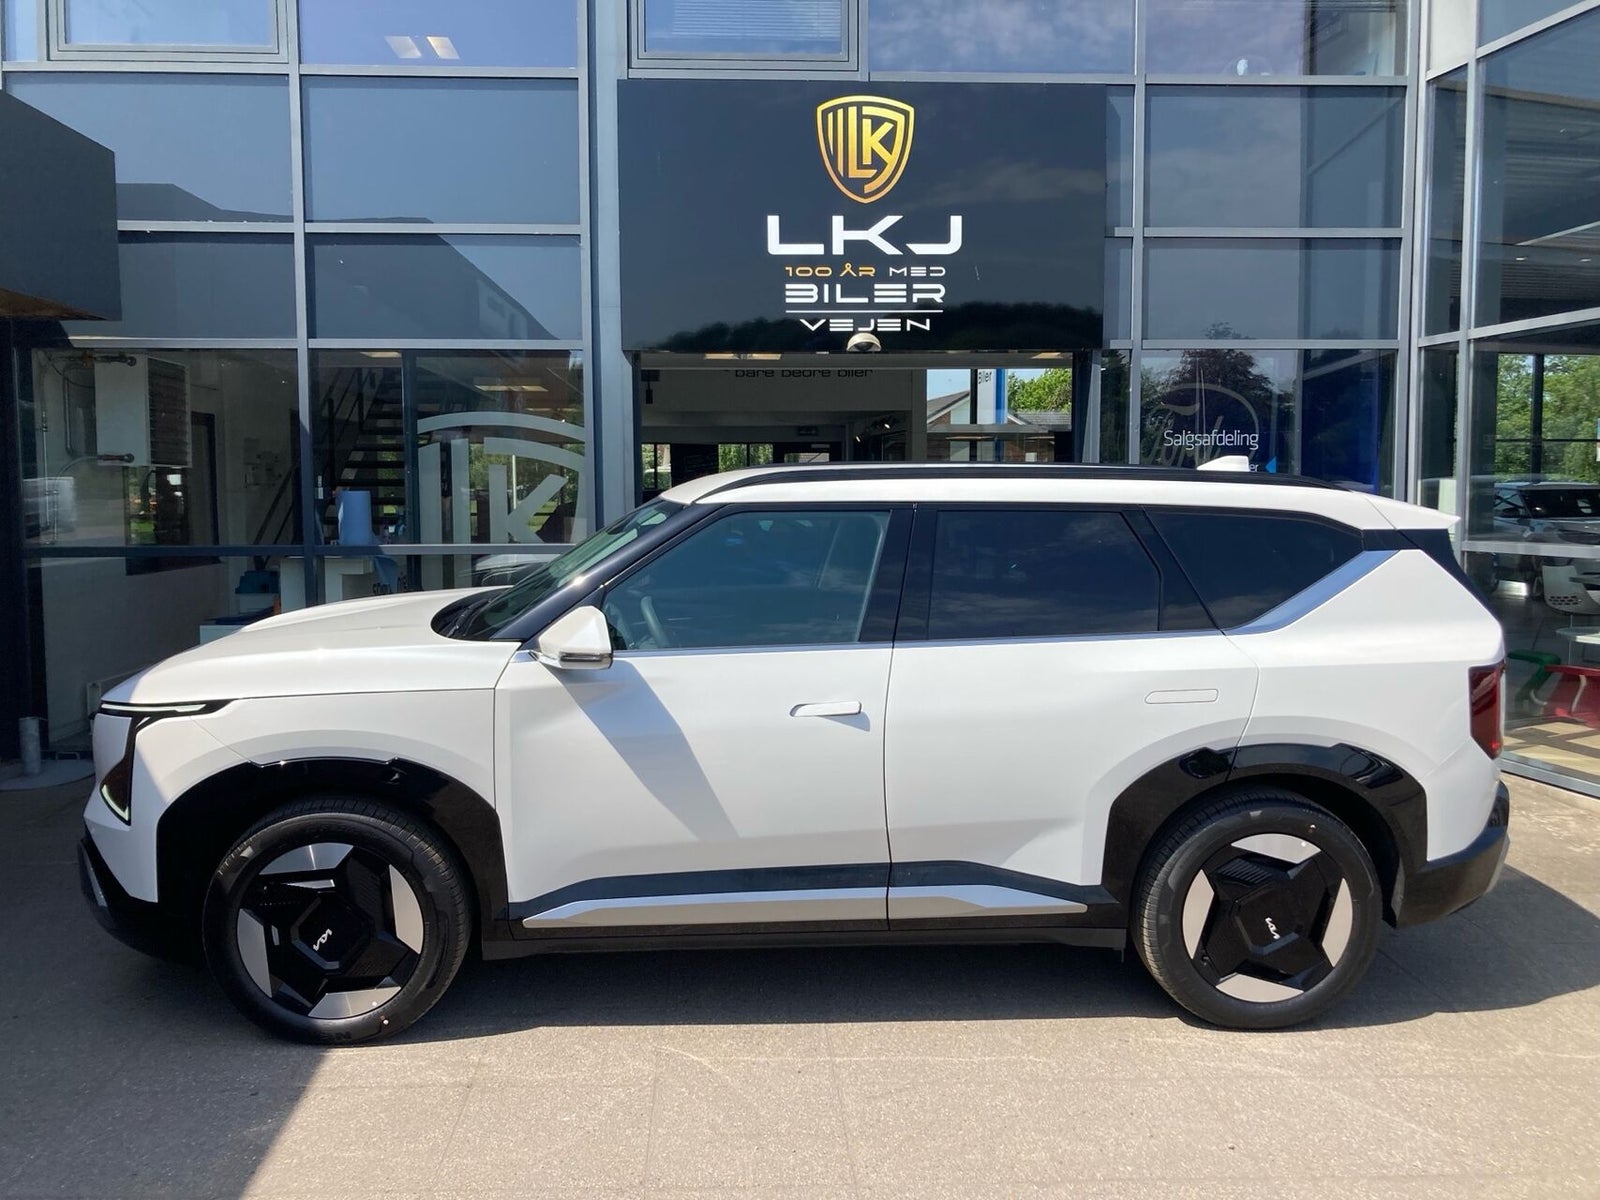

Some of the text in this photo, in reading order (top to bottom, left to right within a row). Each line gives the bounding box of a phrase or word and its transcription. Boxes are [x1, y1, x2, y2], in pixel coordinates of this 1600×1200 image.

[767, 214, 963, 256] LKJ
[785, 262, 946, 277] 100 ÅR MED
[785, 283, 946, 303] BILER
[800, 317, 931, 332] VEJEN
[1163, 429, 1259, 451] Salgsafdeling
